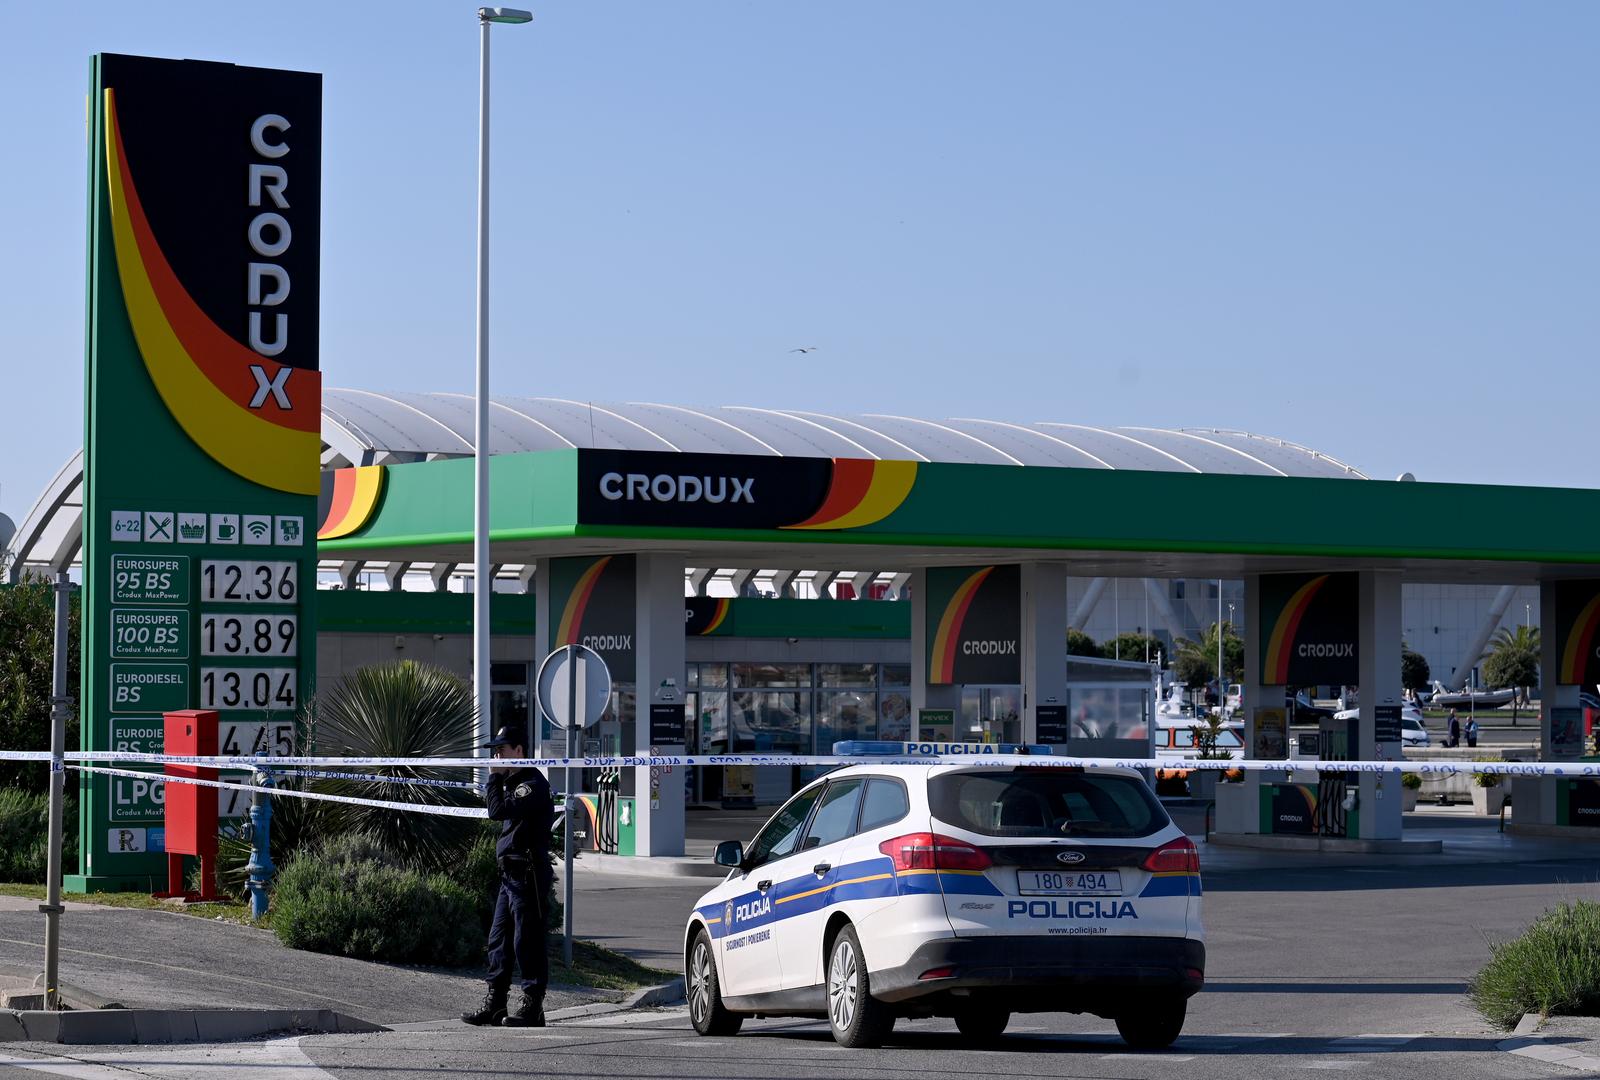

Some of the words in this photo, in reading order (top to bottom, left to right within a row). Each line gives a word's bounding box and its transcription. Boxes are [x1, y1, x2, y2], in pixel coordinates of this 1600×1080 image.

[248, 113, 292, 409] CRODUX
[599, 472, 755, 503] CRODUX
[115, 519, 140, 532] 6-22
[117, 560, 179, 570] EUROSUPER
[116, 572, 140, 589] 95
[145, 572, 171, 589] BS
[117, 591, 142, 599] Crodux
[145, 591, 180, 599] MaxPower
[116, 615, 179, 625] EUROSUPER
[116, 627, 150, 643] 100
[154, 627, 179, 644] BS
[583, 635, 631, 650] CRODUX
[963, 640, 1016, 655] CRODUX
[1298, 643, 1353, 657] CRODUX
[116, 674, 183, 684] EURODIESEL
[116, 686, 142, 702] BS
[922, 714, 951, 722] PEVEX
[116, 728, 164, 738] EURODIE
[117, 741, 140, 753] BS
[907, 743, 994, 755] POLICIJA
[117, 780, 165, 804] LPG
[116, 808, 141, 816] Crodux
[145, 808, 164, 816] MaxP
[1034, 873, 1062, 889] 180
[1076, 873, 1105, 889] 494
[736, 897, 771, 923] POLICIJA
[1008, 900, 1138, 919] POLICIJA
[1048, 926, 1108, 935] www.policija.hr
